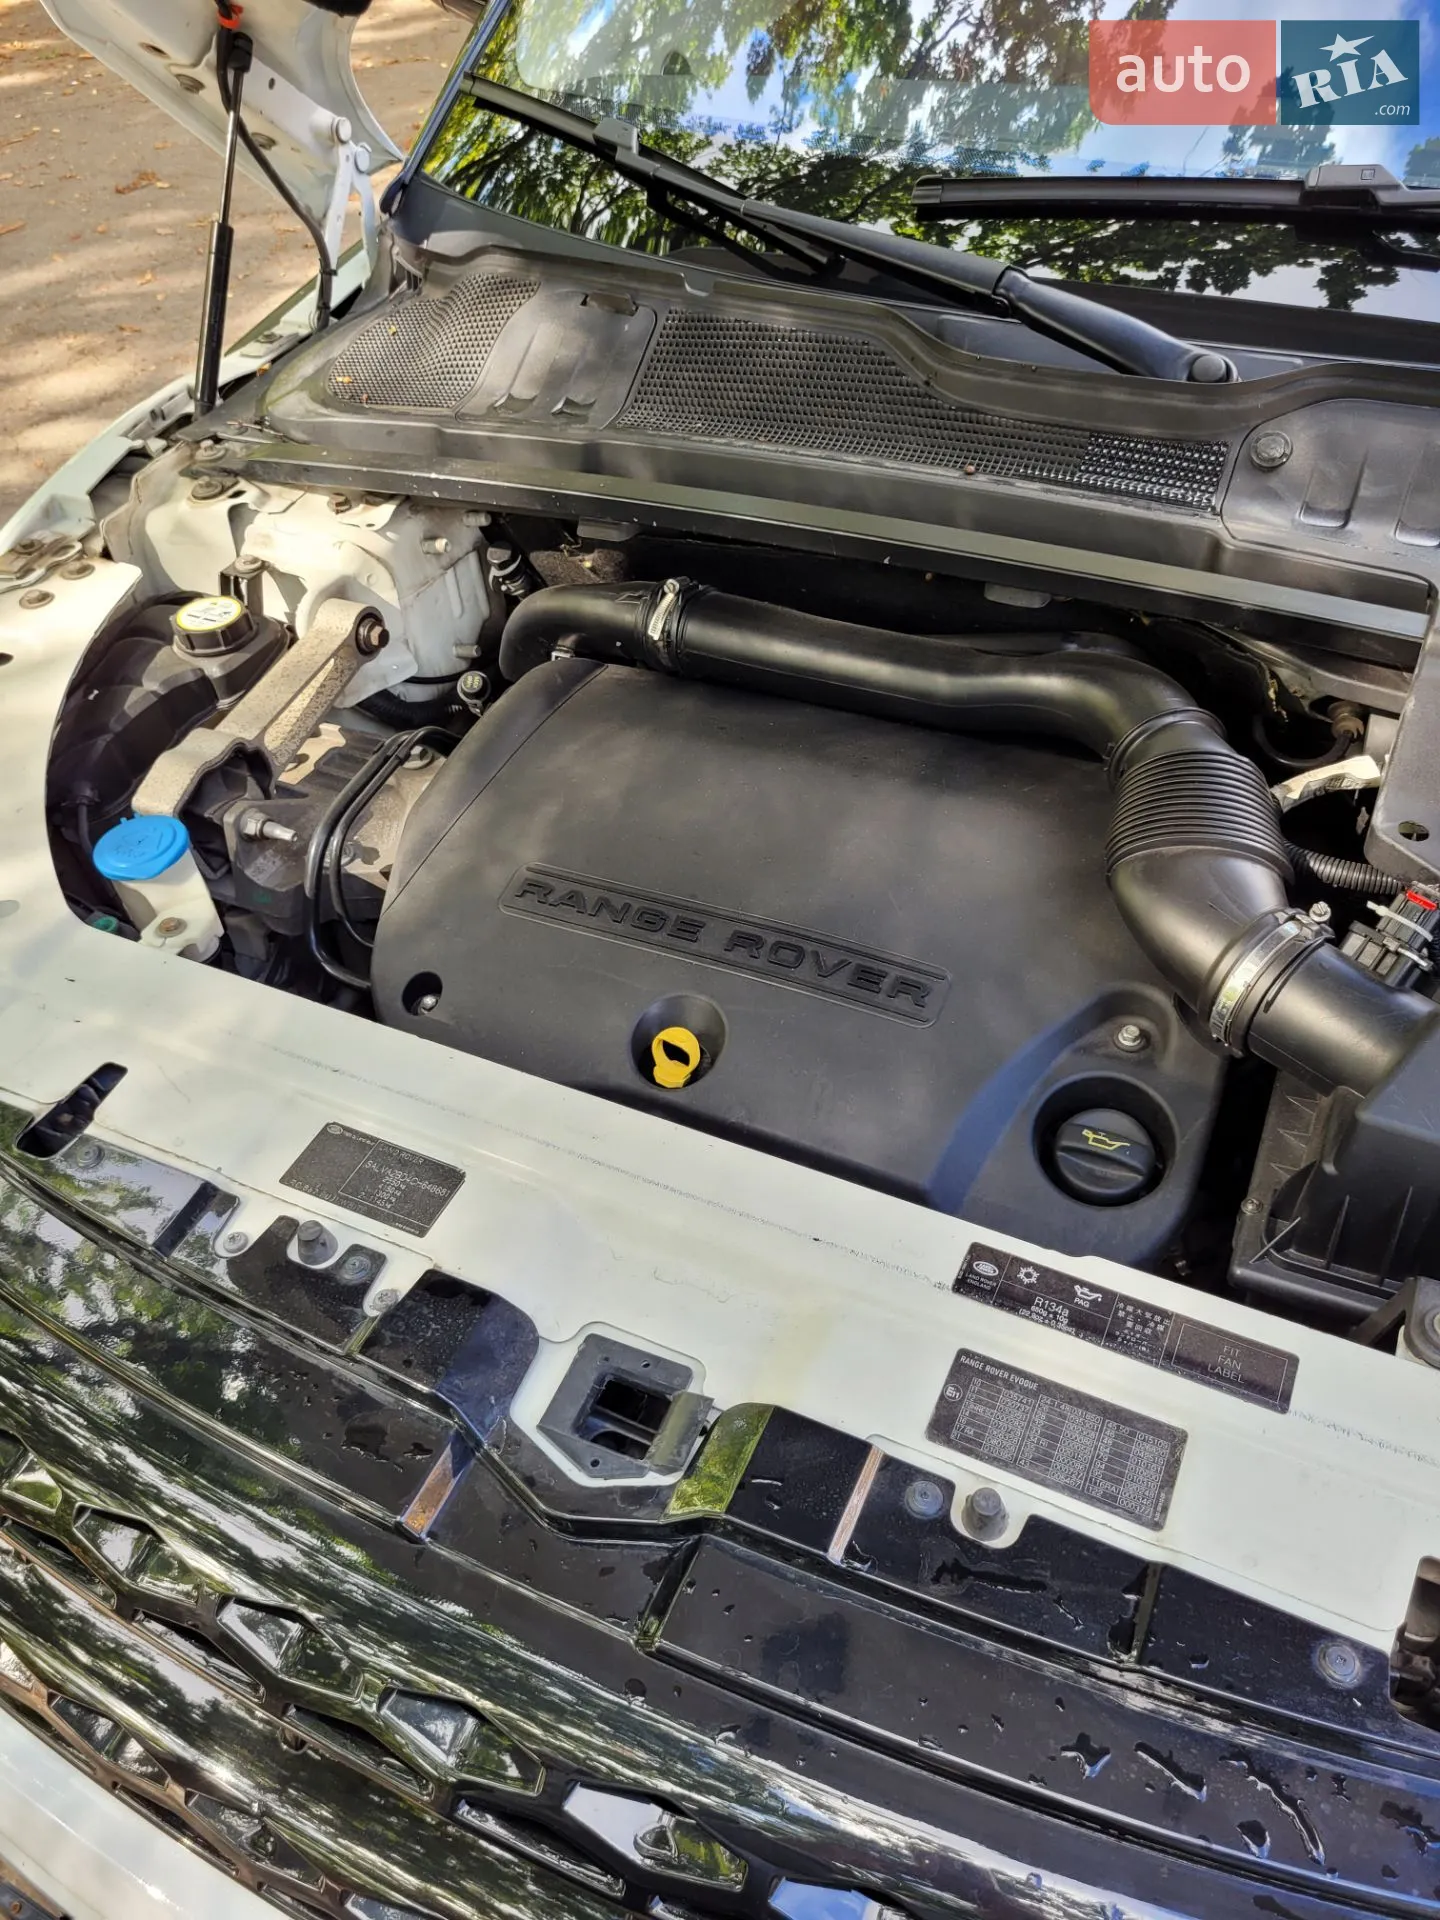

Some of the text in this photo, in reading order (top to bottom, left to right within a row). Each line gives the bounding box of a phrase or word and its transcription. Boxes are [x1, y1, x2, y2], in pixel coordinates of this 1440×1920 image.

[514, 876, 935, 1008] RANGE ROVER
[1034, 1296, 1070, 1317] R134a
[1073, 1297, 1091, 1308] PAG
[1223, 1345, 1241, 1358] FIT
[960, 1355, 985, 1370] RANGE
[985, 1364, 1009, 1379] ROVER
[1217, 1354, 1242, 1371] FAN
[1206, 1363, 1246, 1384] LABEL
